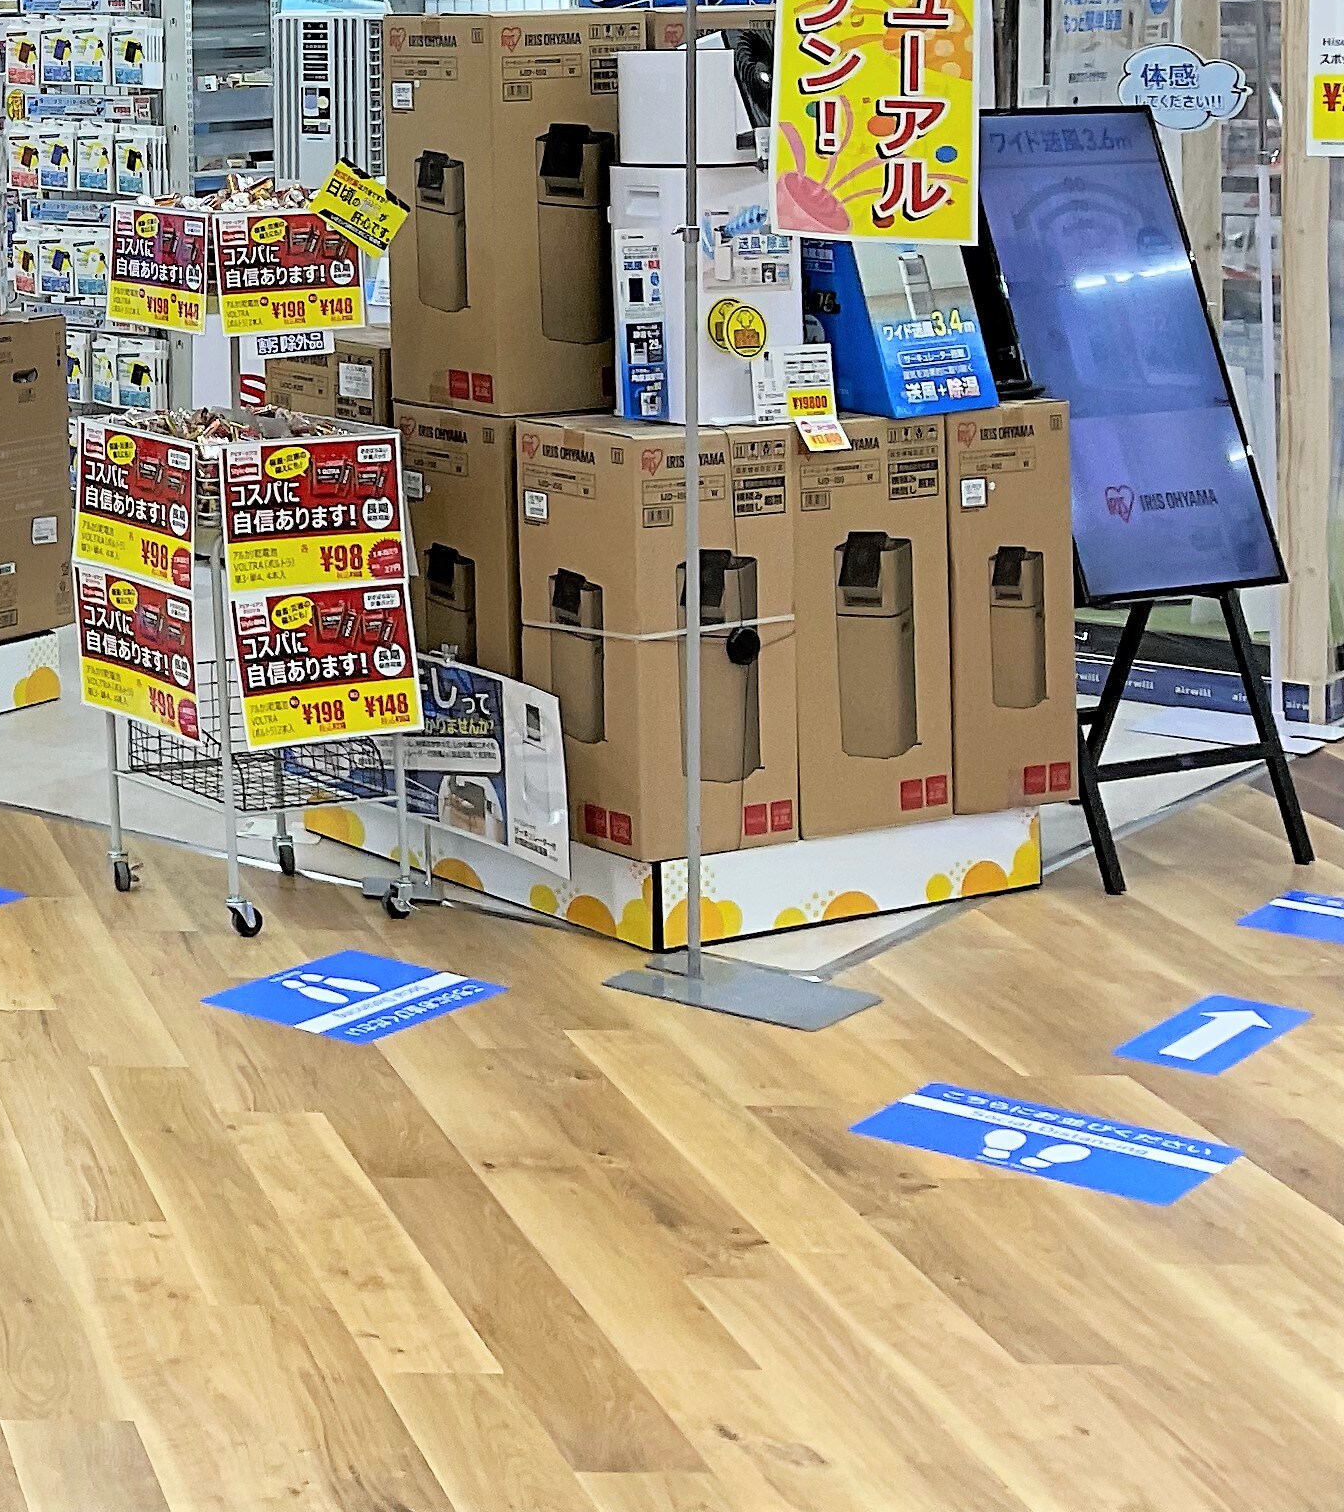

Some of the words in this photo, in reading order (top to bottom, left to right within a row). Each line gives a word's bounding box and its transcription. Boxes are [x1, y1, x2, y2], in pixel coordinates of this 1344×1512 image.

[1140, 63, 1199, 88] 体感
[115, 238, 153, 258] コスパに
[223, 245, 280, 267] コスパに
[225, 264, 326, 288] 自信あります!
[271, 297, 305, 318] ¥198
[84, 460, 128, 488] コスパに
[230, 481, 300, 507] コスパに
[1140, 493, 1165, 511] IRIS
[1167, 489, 1218, 509] OHYAMA
[233, 504, 356, 535] 自信あります!
[141, 539, 168, 569] ¥98
[320, 544, 363, 572] ¥98
[83, 605, 133, 635] コスパに
[242, 631, 308, 659] コスパに
[247, 652, 368, 688] 自信あります!
[148, 686, 174, 721] ¥98
[302, 701, 345, 724] ¥198
[364, 693, 409, 717] ¥148
[972, 1108, 1033, 1132] Social
[1040, 1124, 1148, 1157] Distancing
